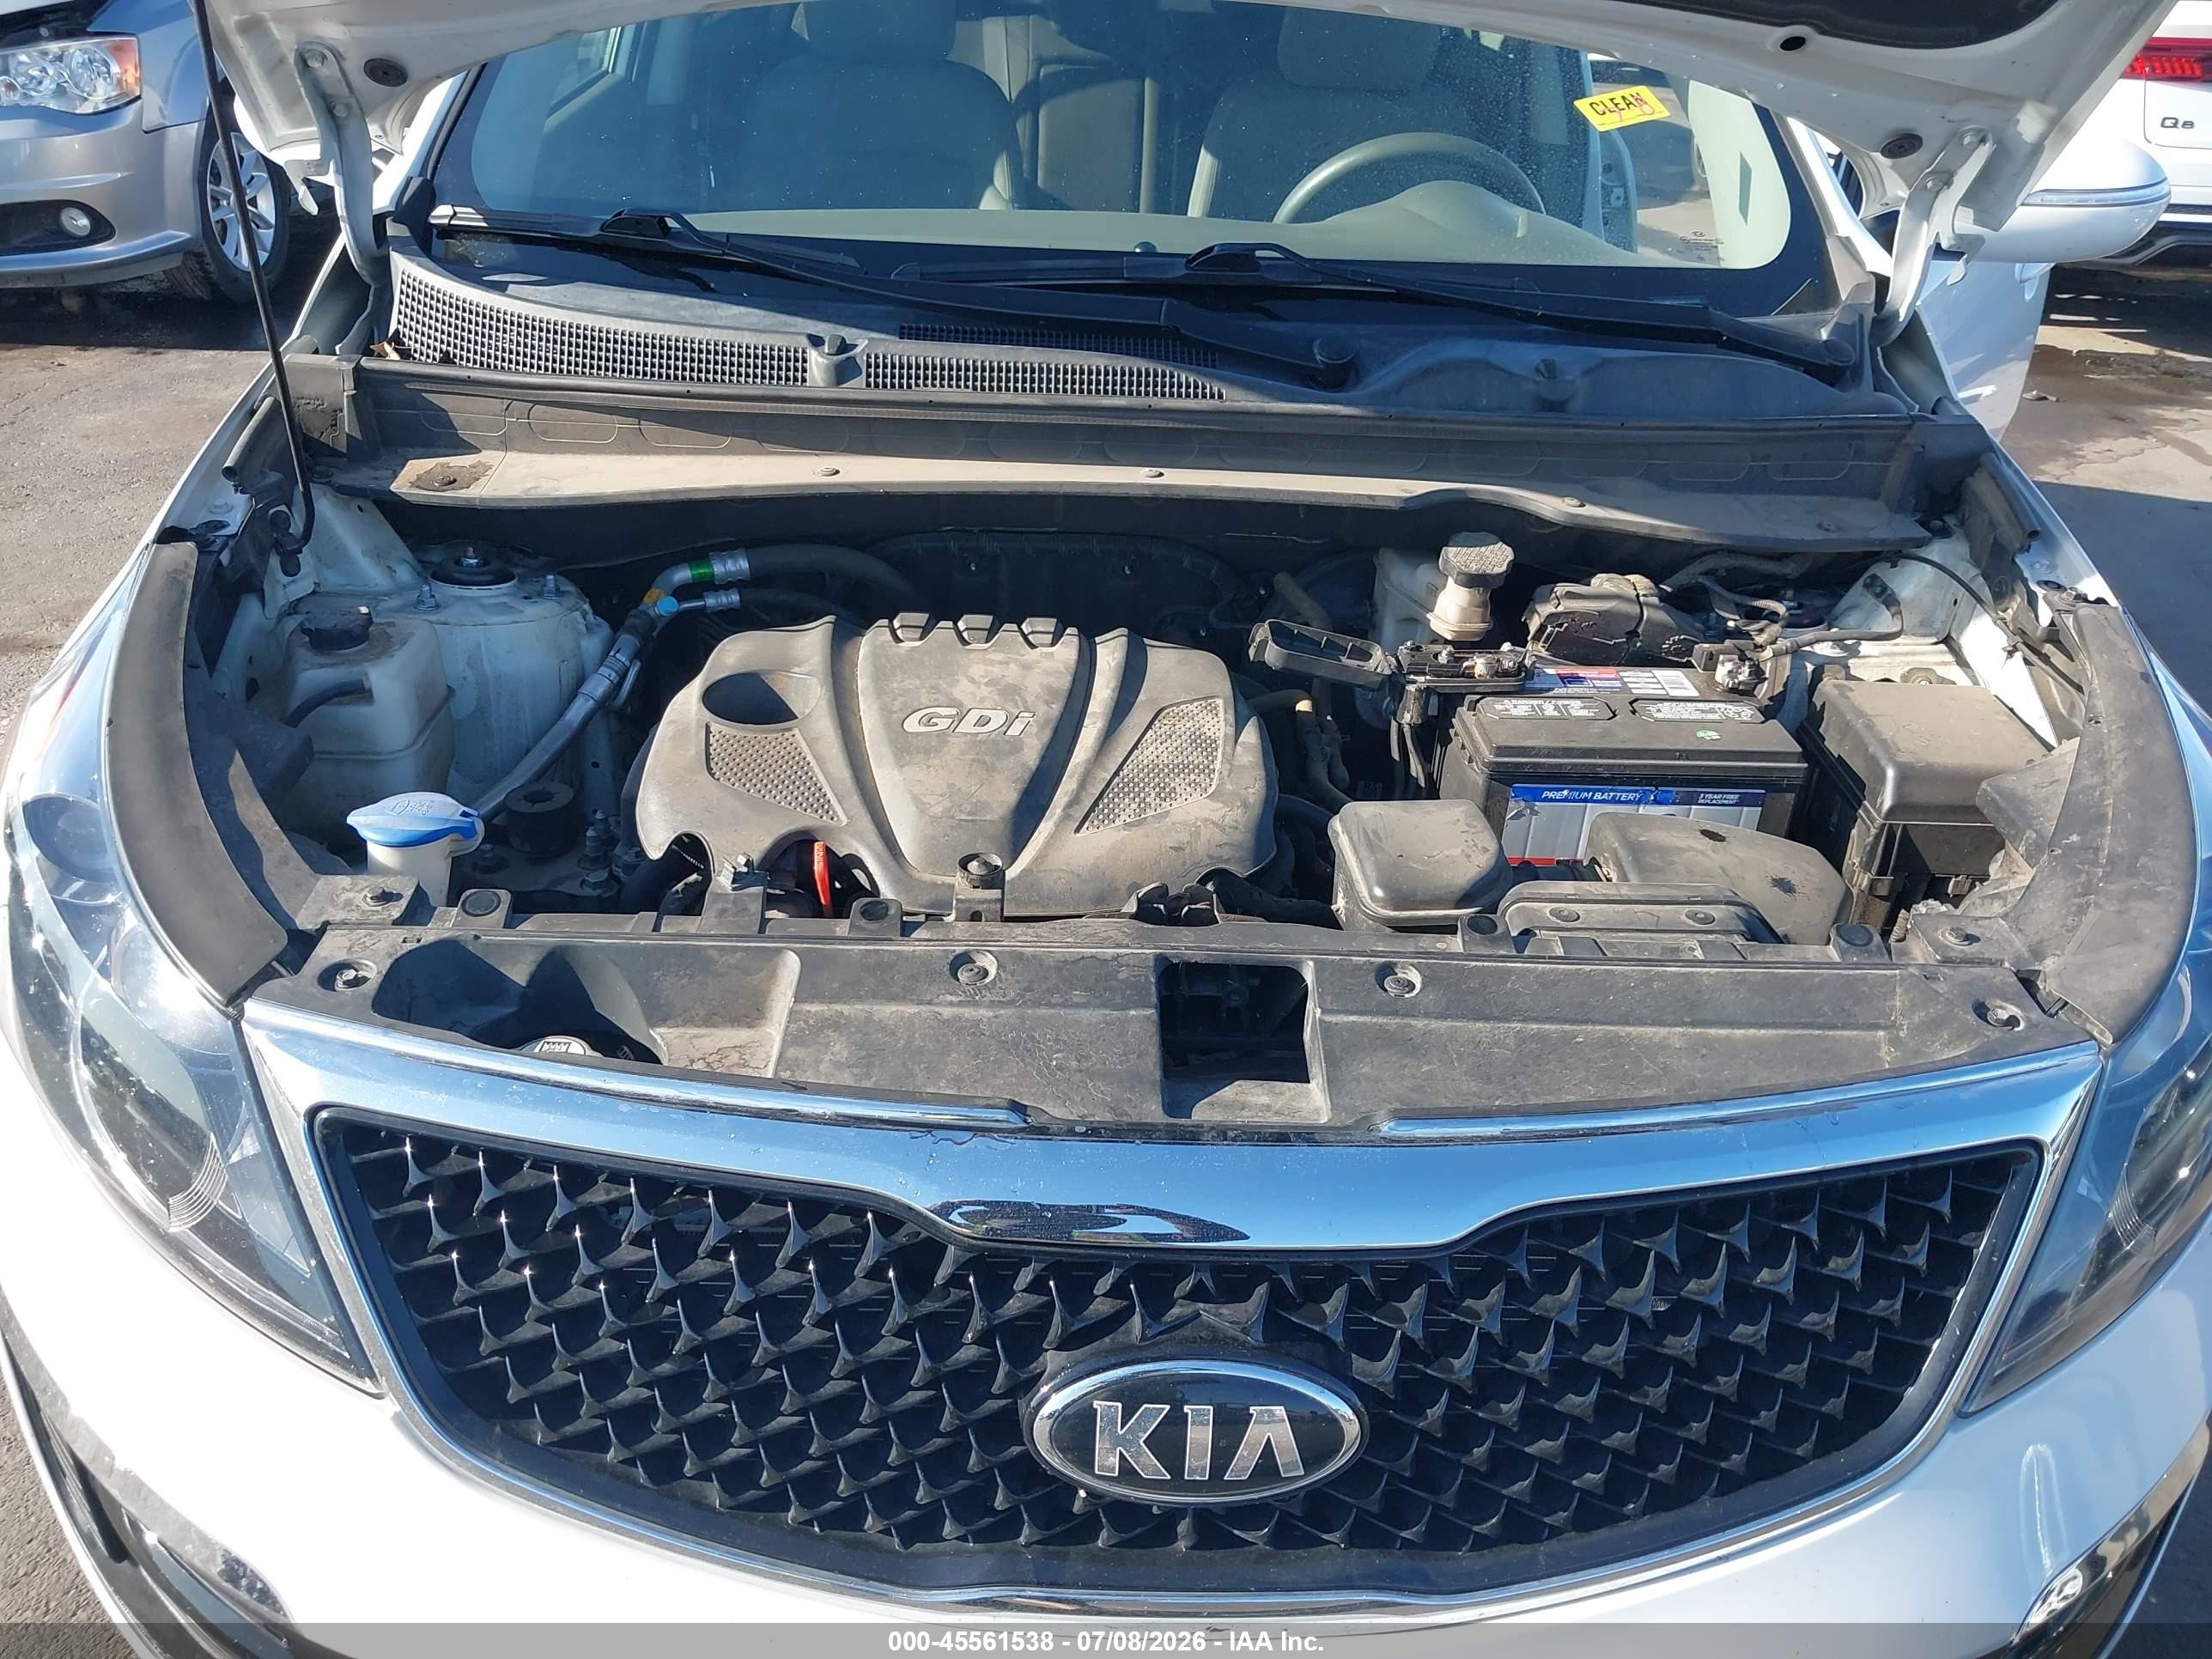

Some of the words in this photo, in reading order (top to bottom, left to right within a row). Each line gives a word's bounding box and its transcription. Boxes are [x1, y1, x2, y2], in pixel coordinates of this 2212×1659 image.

[1589, 93, 1646, 116] CLEAN
[2160, 117, 2195, 129] Q8
[901, 707, 1036, 737] GDi
[1541, 790, 1592, 799] PREMIUM
[1593, 792, 1643, 801] BATTERY
[1093, 1400, 1305, 1480] KIA
